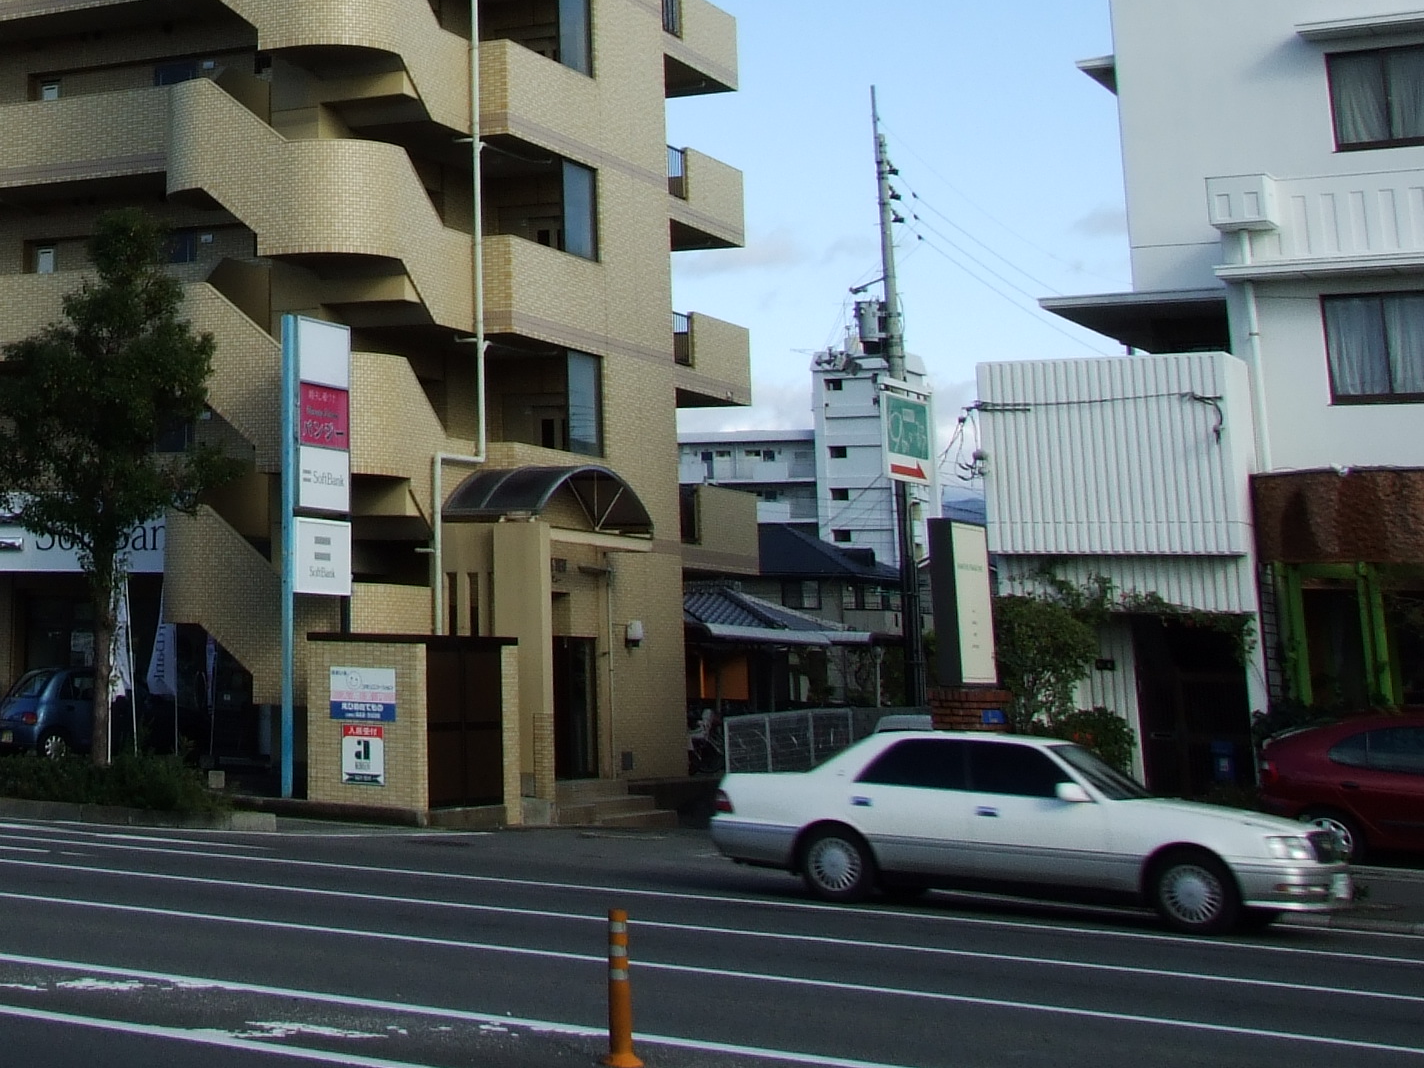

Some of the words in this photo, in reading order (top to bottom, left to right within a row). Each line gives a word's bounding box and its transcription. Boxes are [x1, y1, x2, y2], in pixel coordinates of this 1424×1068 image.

[303, 420, 345, 441] パンジー
[313, 471, 344, 487] SoftBank
[309, 566, 336, 579] SoftBank
